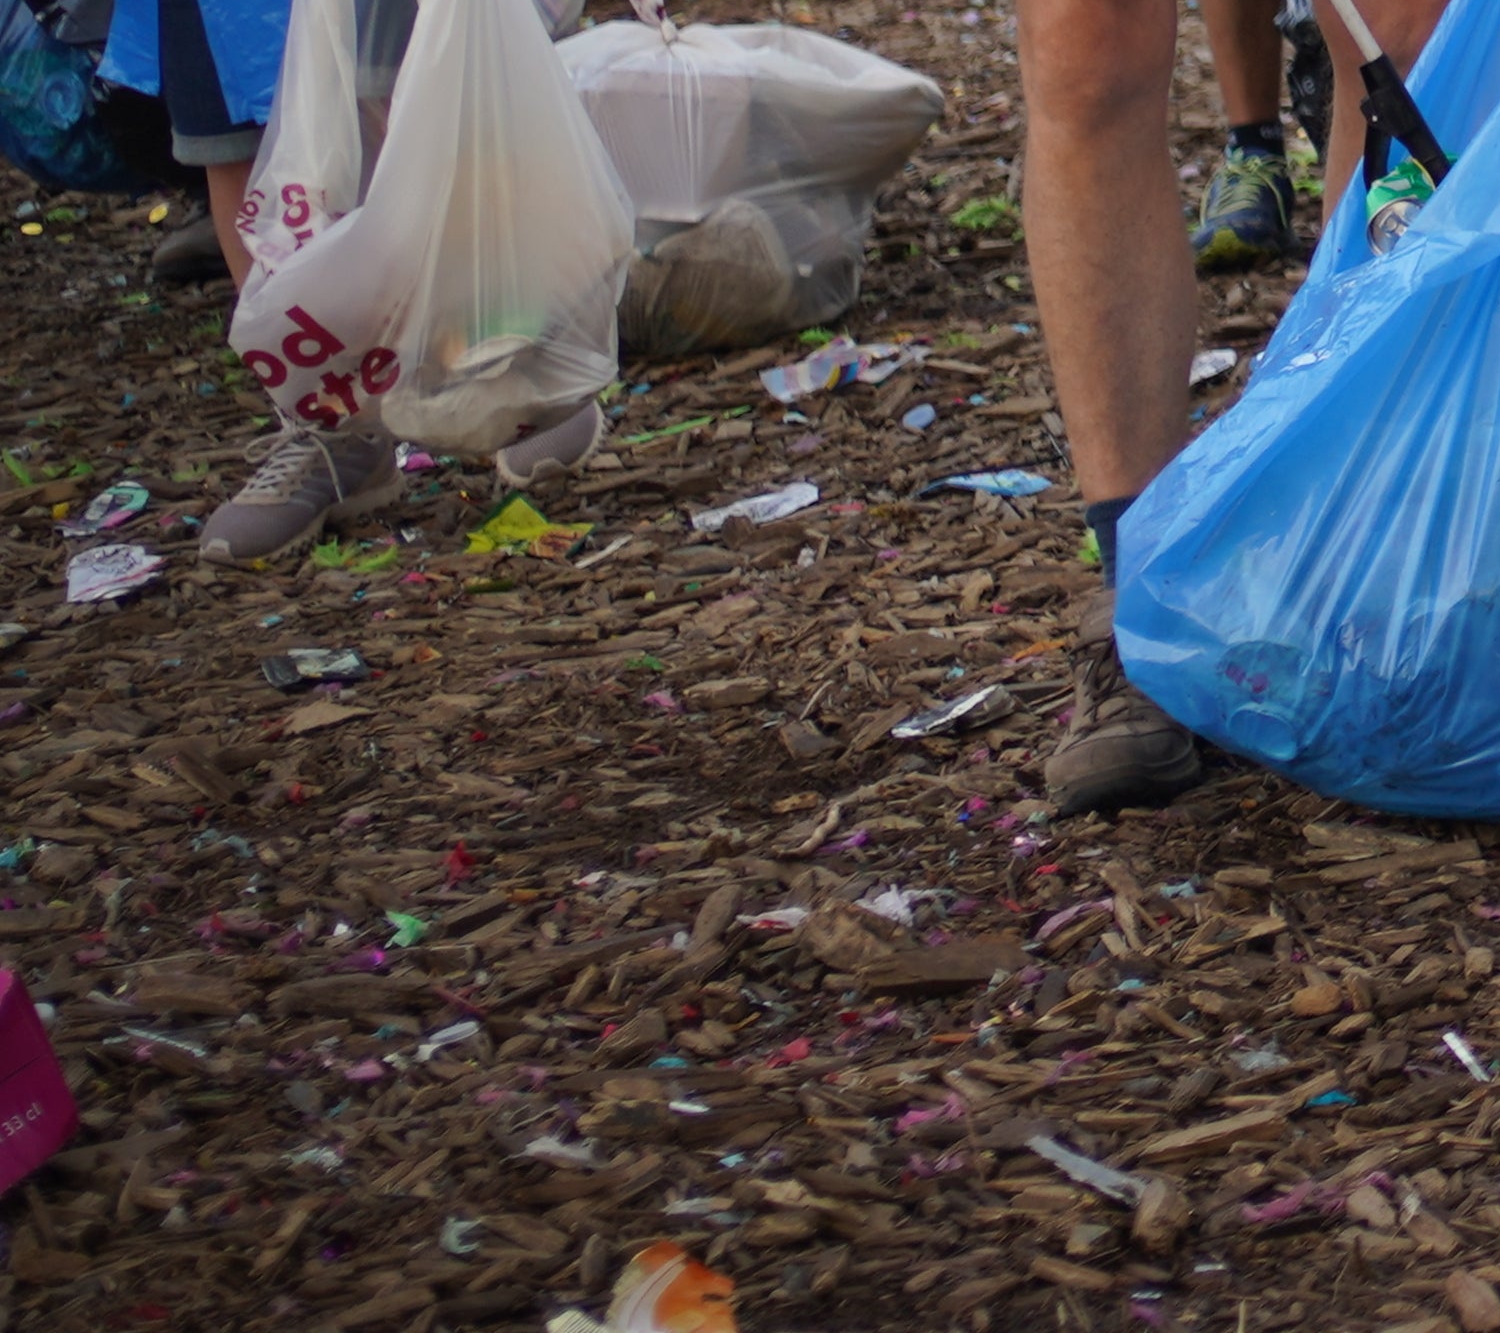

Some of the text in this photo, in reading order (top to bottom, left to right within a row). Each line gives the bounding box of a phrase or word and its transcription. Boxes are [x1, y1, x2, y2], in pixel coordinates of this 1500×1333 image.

[241, 305, 346, 388] od
[295, 346, 400, 429] ste
[1, 1102, 42, 1137] 33 cl
